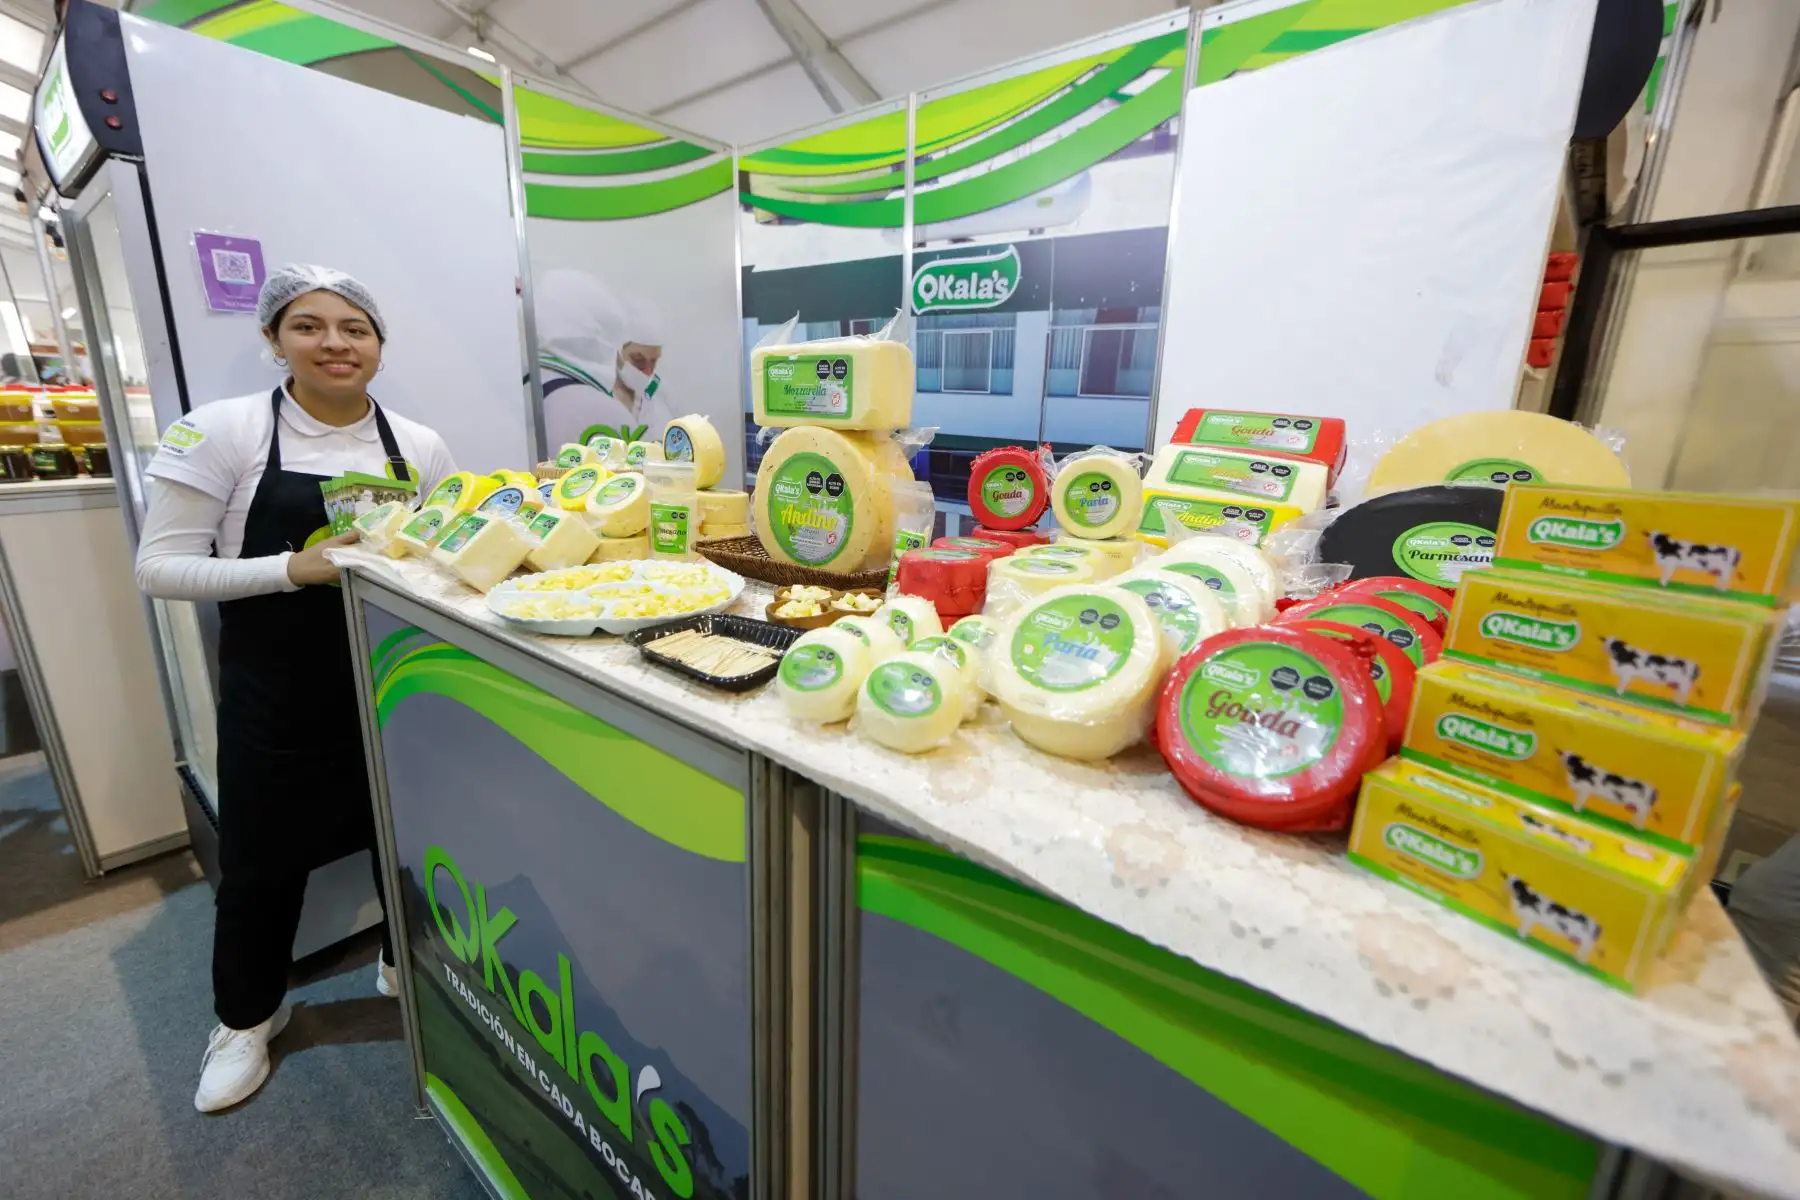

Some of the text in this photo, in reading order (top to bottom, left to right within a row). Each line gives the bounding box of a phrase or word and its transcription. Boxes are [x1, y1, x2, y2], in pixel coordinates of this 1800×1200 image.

[783, 384, 827, 396] Mozzarella
[1231, 425, 1275, 439] Gouda
[992, 489, 1022, 502] Gouda
[781, 503, 838, 531] Andino
[1534, 520, 1616, 544] QKala's
[1409, 549, 1491, 563] Parmesan
[1487, 616, 1571, 645] QKala's
[1205, 690, 1302, 739] Gouda
[1442, 717, 1527, 755] QKala's
[1391, 826, 1473, 873] QKala's
[443, 962, 516, 1054] TRADICIÓN
[515, 1043, 537, 1080] EN
[537, 1069, 586, 1137] CADA
